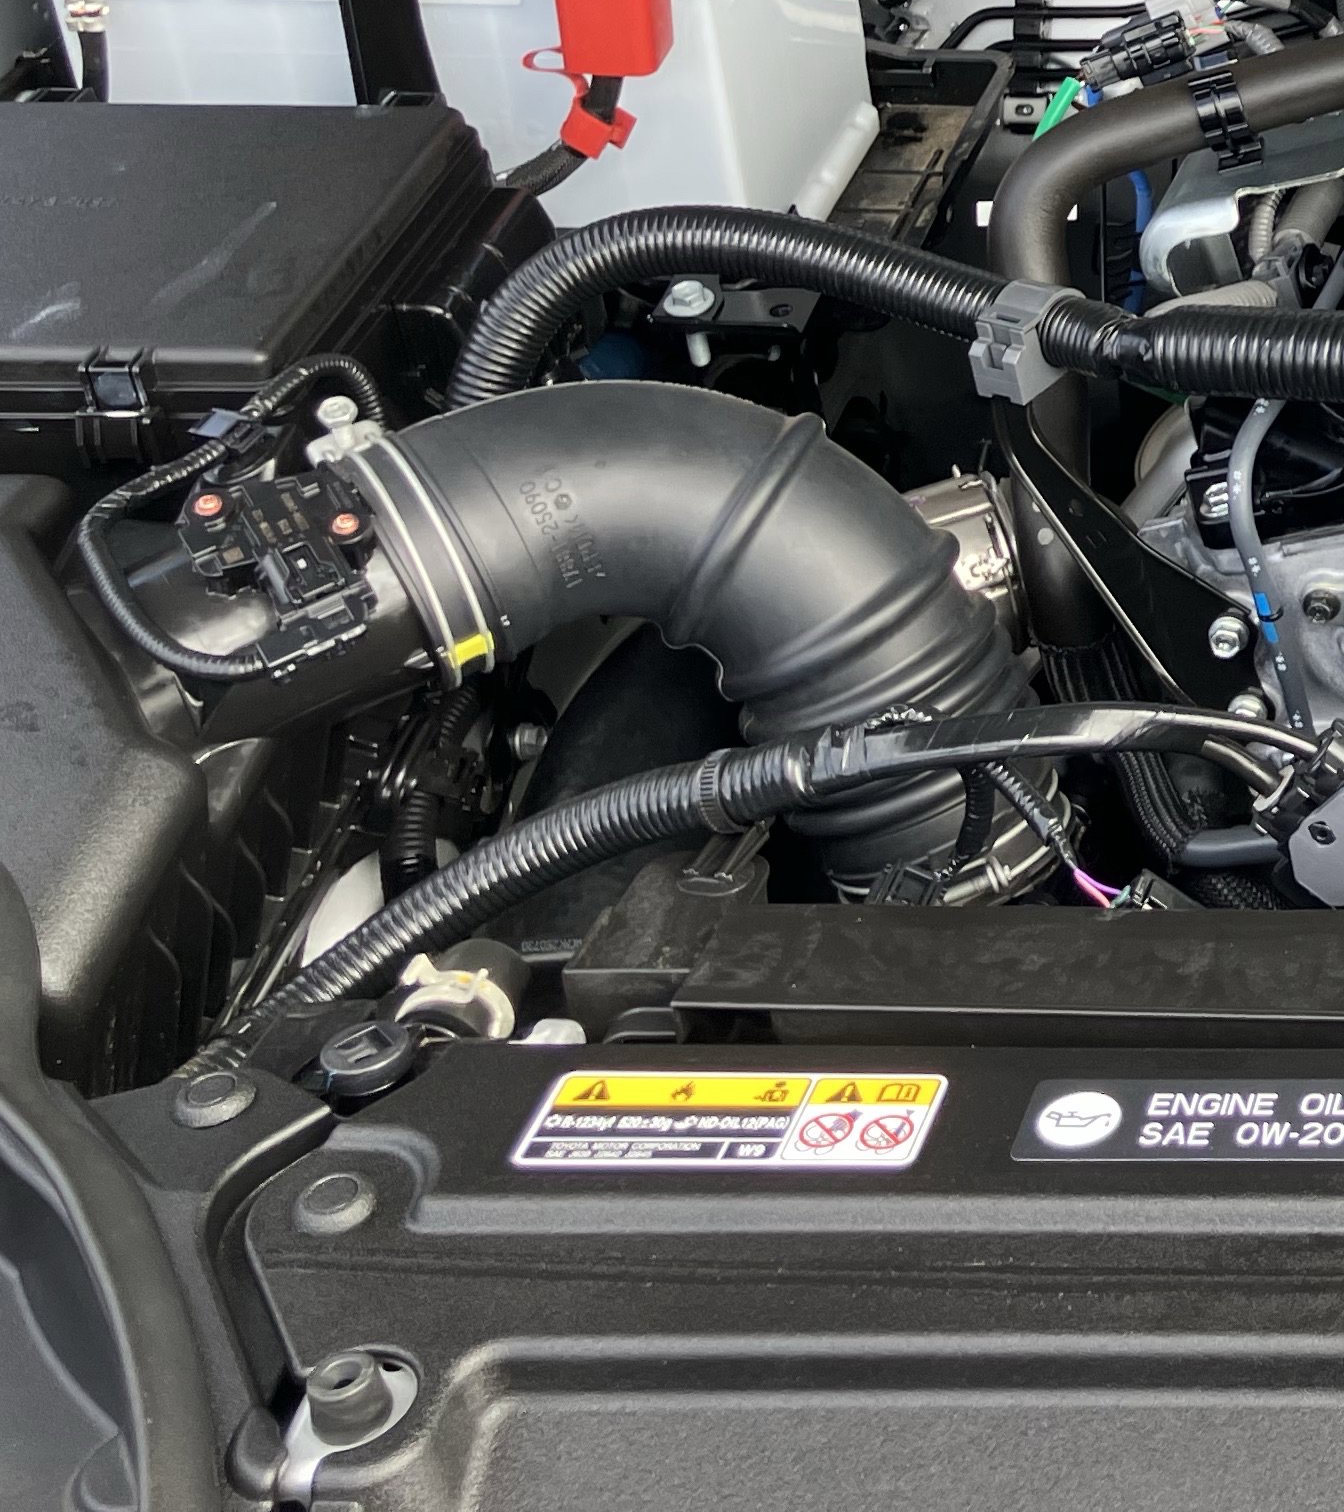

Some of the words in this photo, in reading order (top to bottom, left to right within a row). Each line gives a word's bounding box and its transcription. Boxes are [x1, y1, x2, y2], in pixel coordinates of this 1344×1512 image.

[1147, 1092, 1279, 1116] ENGINE
[1138, 1121, 1215, 1146] SAE
[551, 1141, 589, 1151] TOYOTA
[592, 1141, 630, 1151] MOTOR
[631, 1141, 703, 1151] CORPORATION
